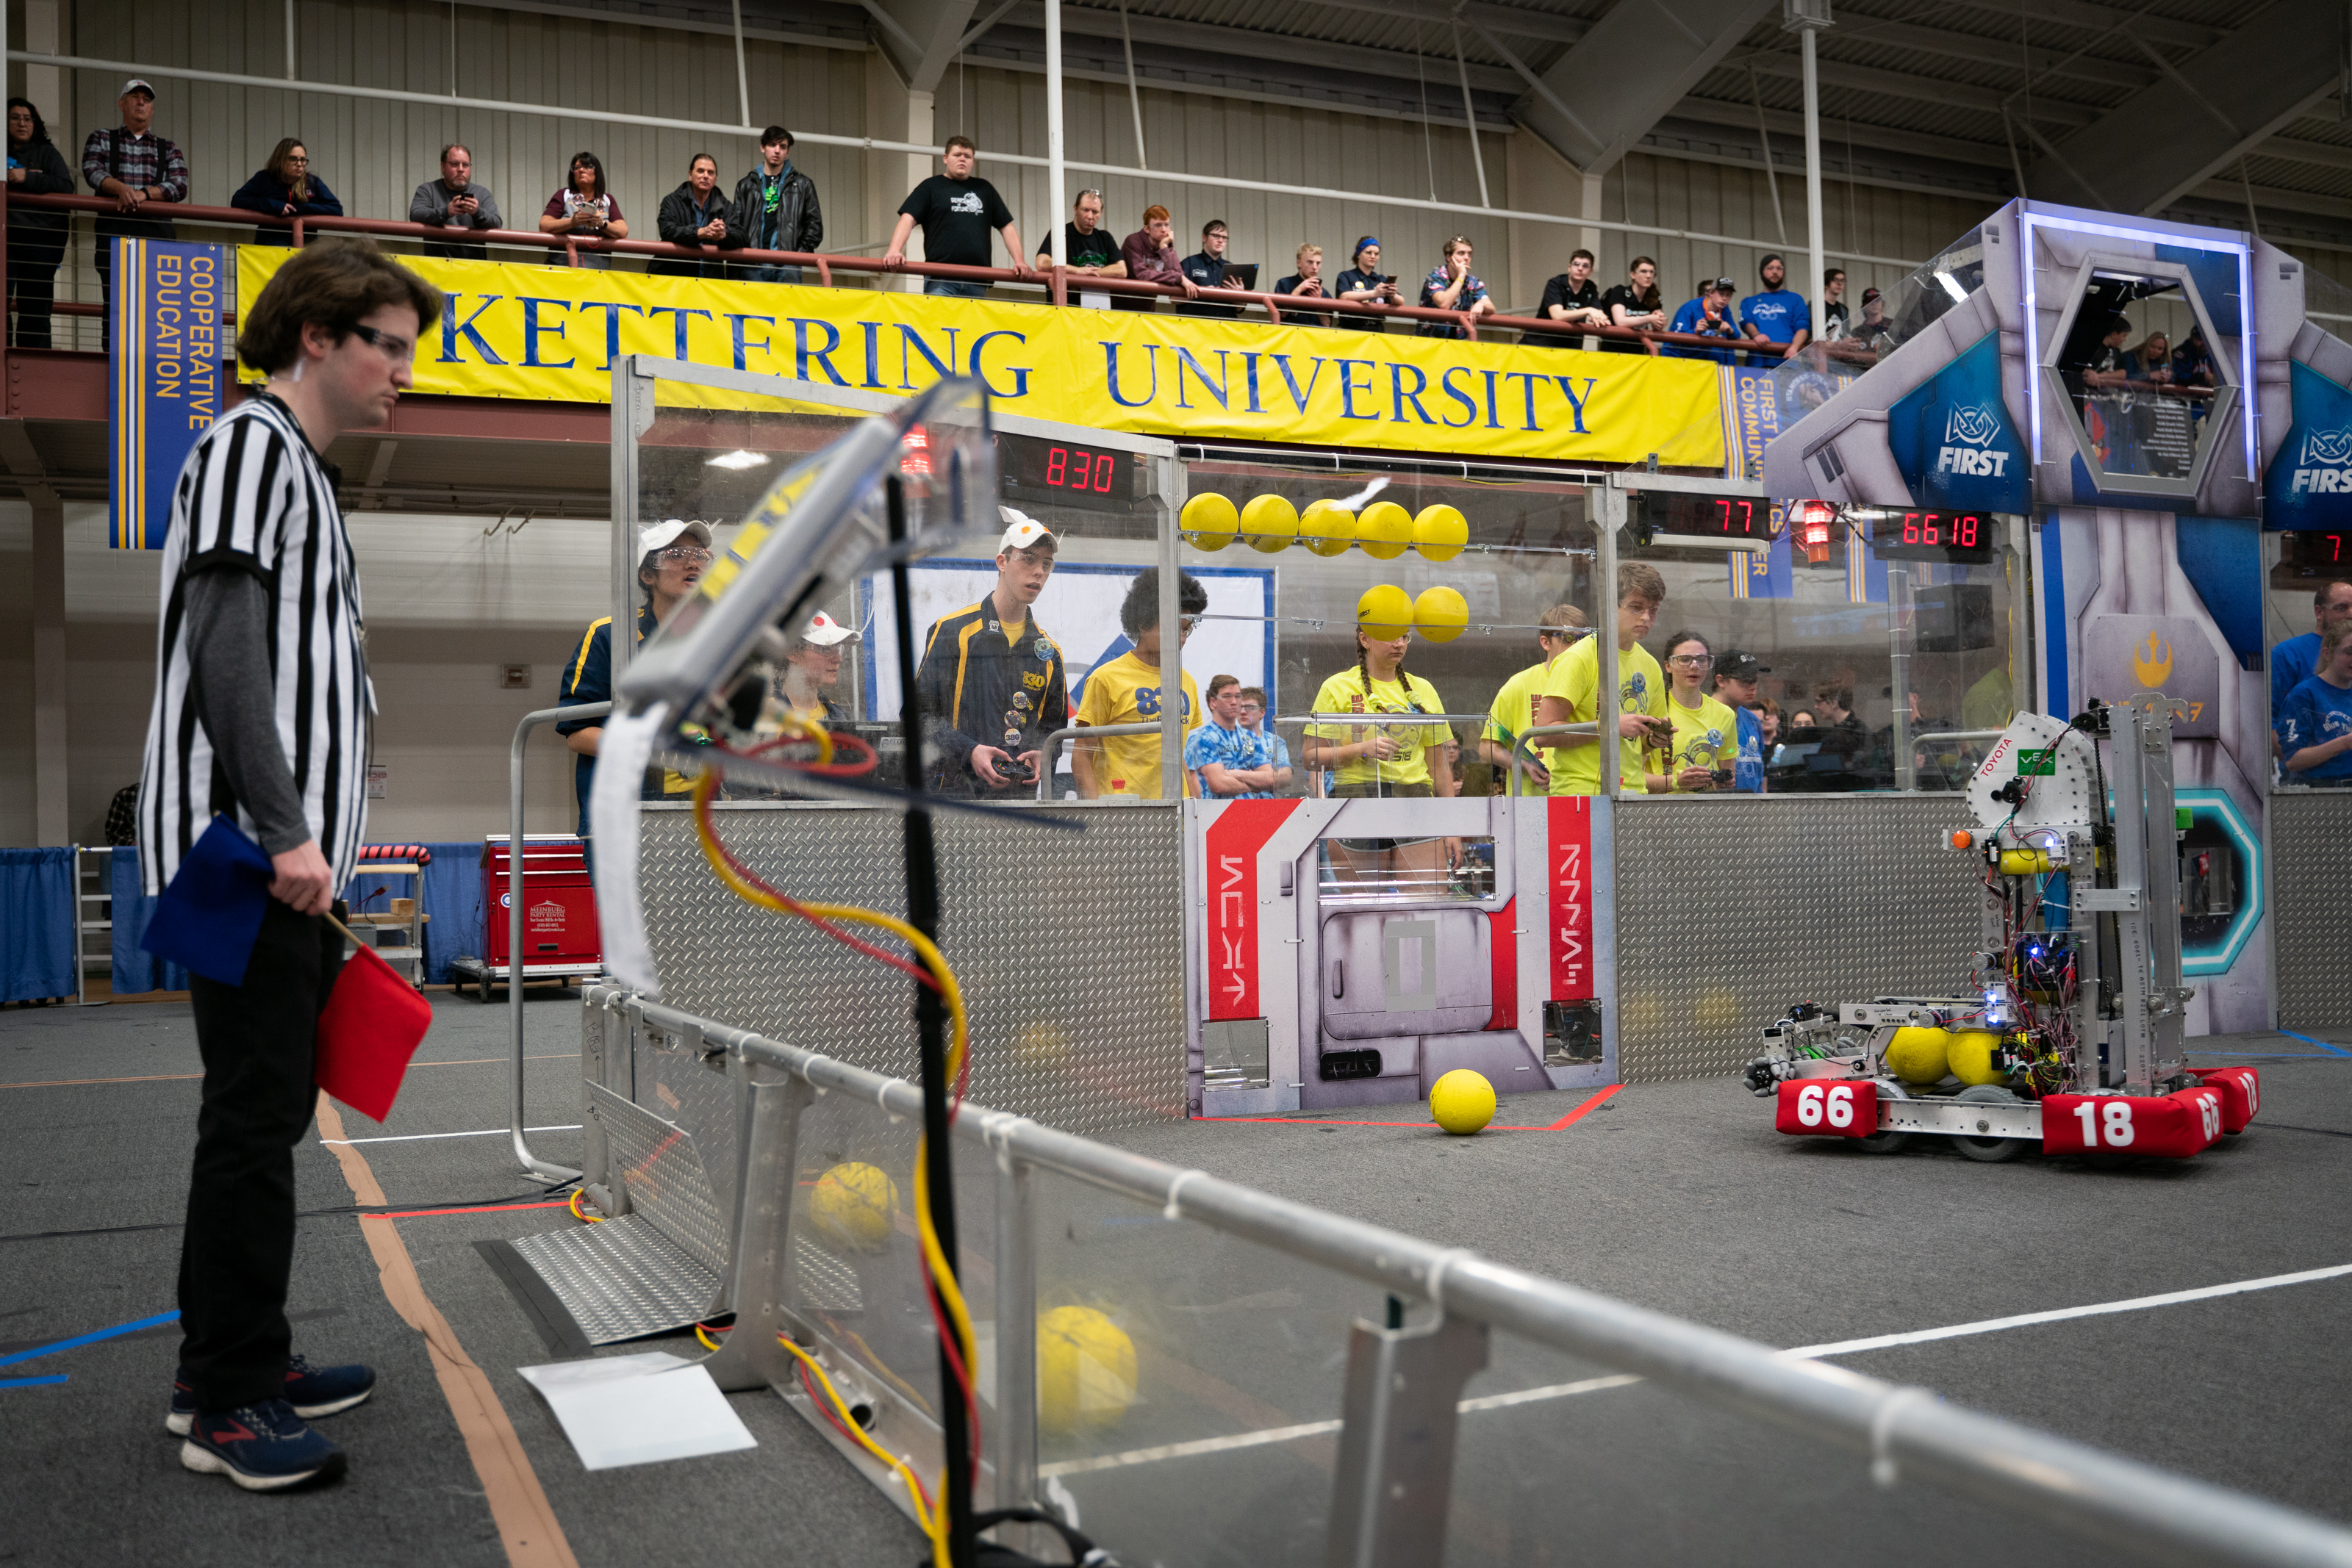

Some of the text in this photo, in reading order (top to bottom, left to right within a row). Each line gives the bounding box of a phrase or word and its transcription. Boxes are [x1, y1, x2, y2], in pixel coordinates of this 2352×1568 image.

[156, 254, 182, 398] EDUCATION
[190, 256, 215, 429] COOPERATIVE
[436, 292, 1598, 435] KETTERING UNIVERSITY
[1759, 379, 1779, 434] FIRST
[1047, 447, 1114, 493] 830
[1937, 446, 2009, 477] FIRST
[1715, 500, 1752, 533] 77
[1903, 513, 1978, 547] 6618
[2323, 721, 2340, 732] Blue
[1980, 738, 2012, 777] TOYOTA
[2019, 764, 2054, 772] PRO
[1797, 1085, 1854, 1128] 66
[2196, 1093, 2220, 1141] 66
[2238, 1072, 2257, 1117] 18
[2073, 1101, 2134, 1147] 18
